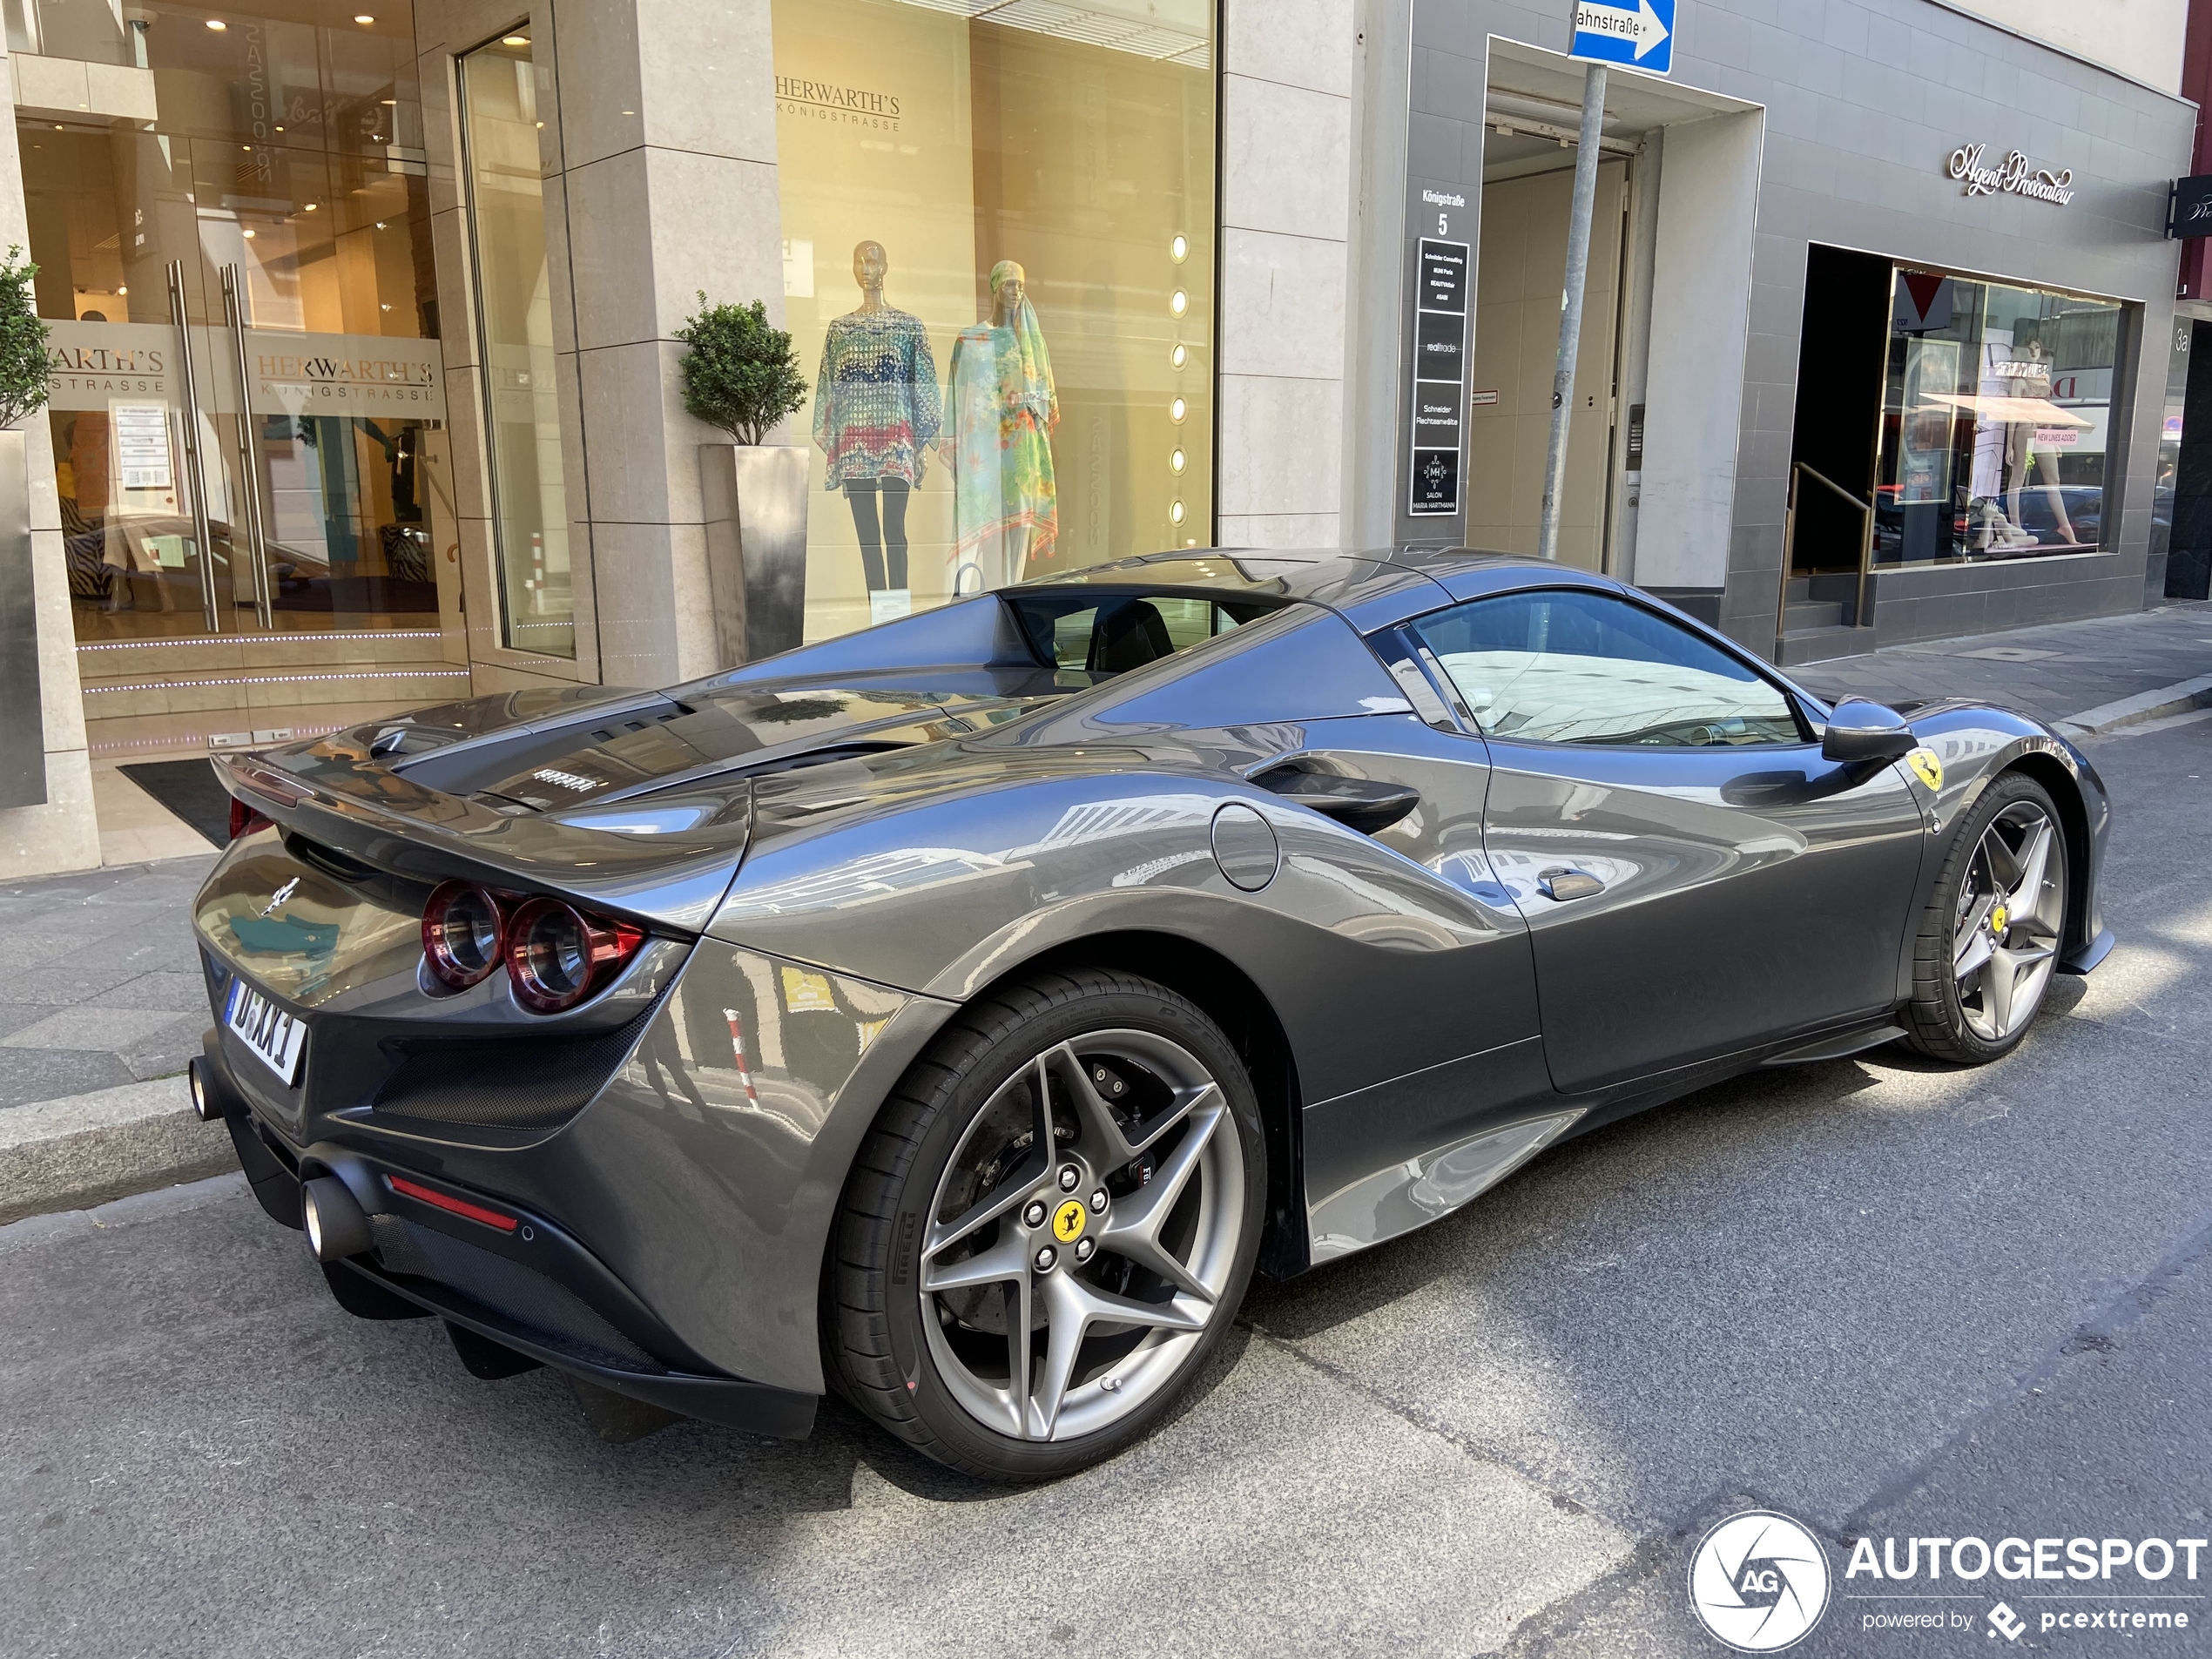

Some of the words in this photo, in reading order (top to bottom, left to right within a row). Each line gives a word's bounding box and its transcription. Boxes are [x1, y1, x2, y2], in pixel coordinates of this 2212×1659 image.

[1577, 9, 1639, 36] ahnstraße
[774, 75, 900, 115] HERWARTH'S
[776, 102, 900, 132] KÖNIGSTRASSE
[1950, 143, 2007, 196] Agent
[2003, 149, 2075, 206] Provocateur
[1422, 189, 1465, 207] Königstraße
[1438, 212, 1447, 235] 5
[2175, 327, 2188, 352] 3a
[258, 354, 433, 383] HERWARTH'S
[1423, 405, 1453, 414] Schneider
[892, 1211, 916, 1285] PIRELLI
